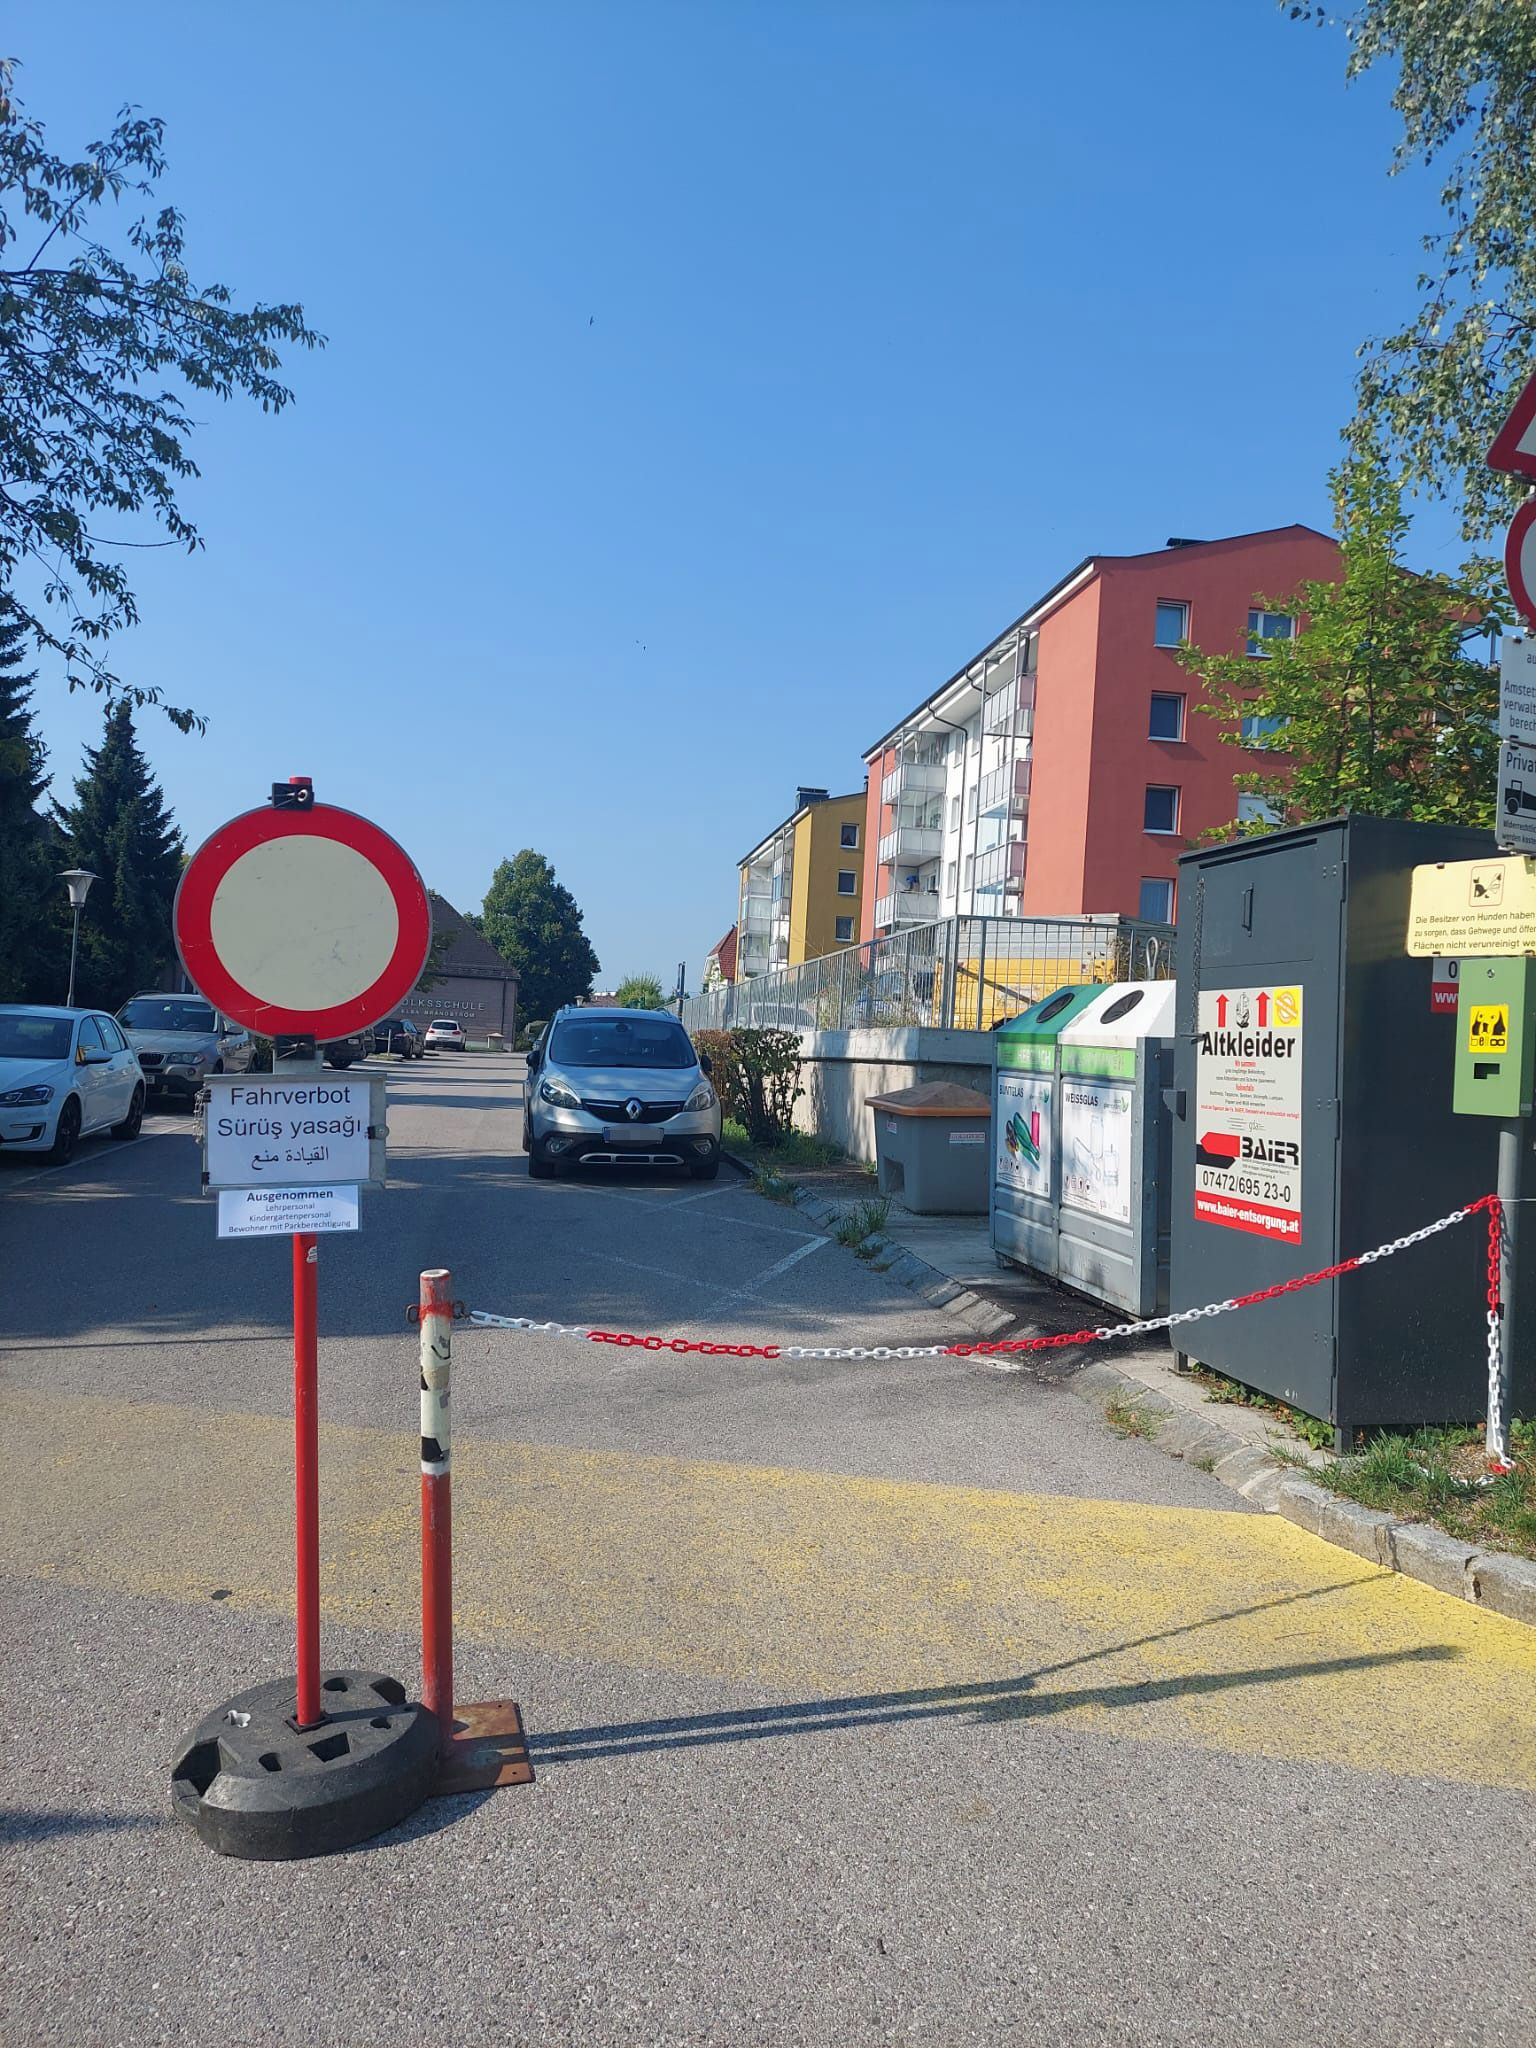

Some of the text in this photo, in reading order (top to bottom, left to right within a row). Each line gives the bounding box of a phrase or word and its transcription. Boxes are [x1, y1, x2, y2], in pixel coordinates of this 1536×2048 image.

[1415, 910, 1536, 924] Die Besitzer von Hunden haben
[1423, 928, 1449, 938] sorgen,
[1450, 927, 1467, 936] dass
[1468, 926, 1501, 937] Gehwege
[1502, 925, 1518, 934] und
[1413, 940, 1445, 950] Flächen
[1445, 940, 1466, 949] nicht
[1468, 938, 1520, 950] verunreinigt
[401, 999, 486, 1011] OLKSSCHULE
[1201, 1030, 1297, 1058] Altkleider
[231, 1086, 351, 1106] Fahrverbot
[1064, 1092, 1099, 1107] WEISSGLAS
[217, 1115, 361, 1140] Sürüş yasağı
[251, 1145, 329, 1171] القيادة منع
[1202, 1170, 1260, 1197] 07472/695
[1263, 1182, 1291, 1203] 23-0
[246, 1190, 334, 1203] Ausgenommen
[265, 1202, 316, 1212] Lehrpersonal
[249, 1211, 332, 1223] Kindergartenpersonal
[1197, 1199, 1300, 1234] www.baier-entsorgung.at
[228, 1220, 351, 1233] Bewohner mit Parkberechtigung
